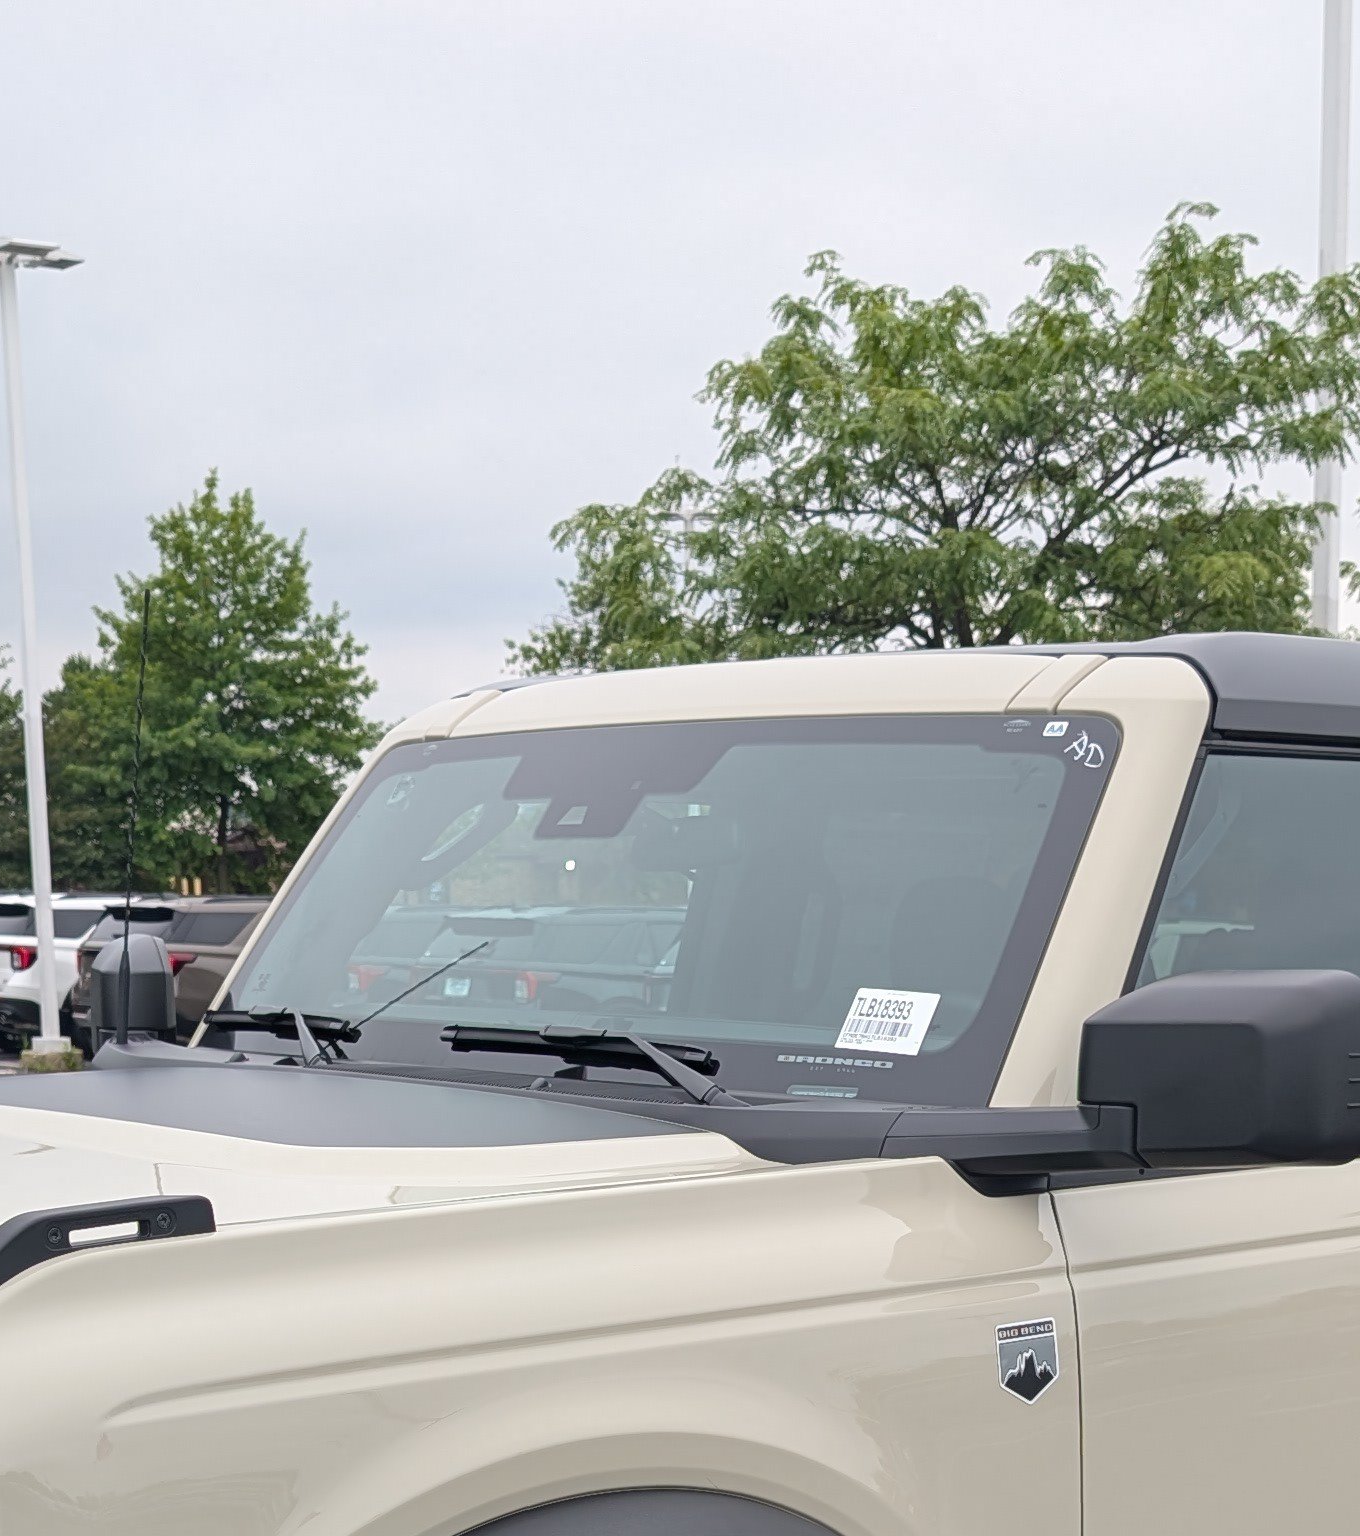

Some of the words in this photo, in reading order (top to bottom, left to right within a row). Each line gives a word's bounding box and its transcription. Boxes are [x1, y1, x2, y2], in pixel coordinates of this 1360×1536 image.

[853, 997, 914, 1020] TLB18393
[777, 1055, 894, 1068] BRONCO
[999, 1329, 1018, 1338] BIG
[1021, 1324, 1052, 1335] BEND
